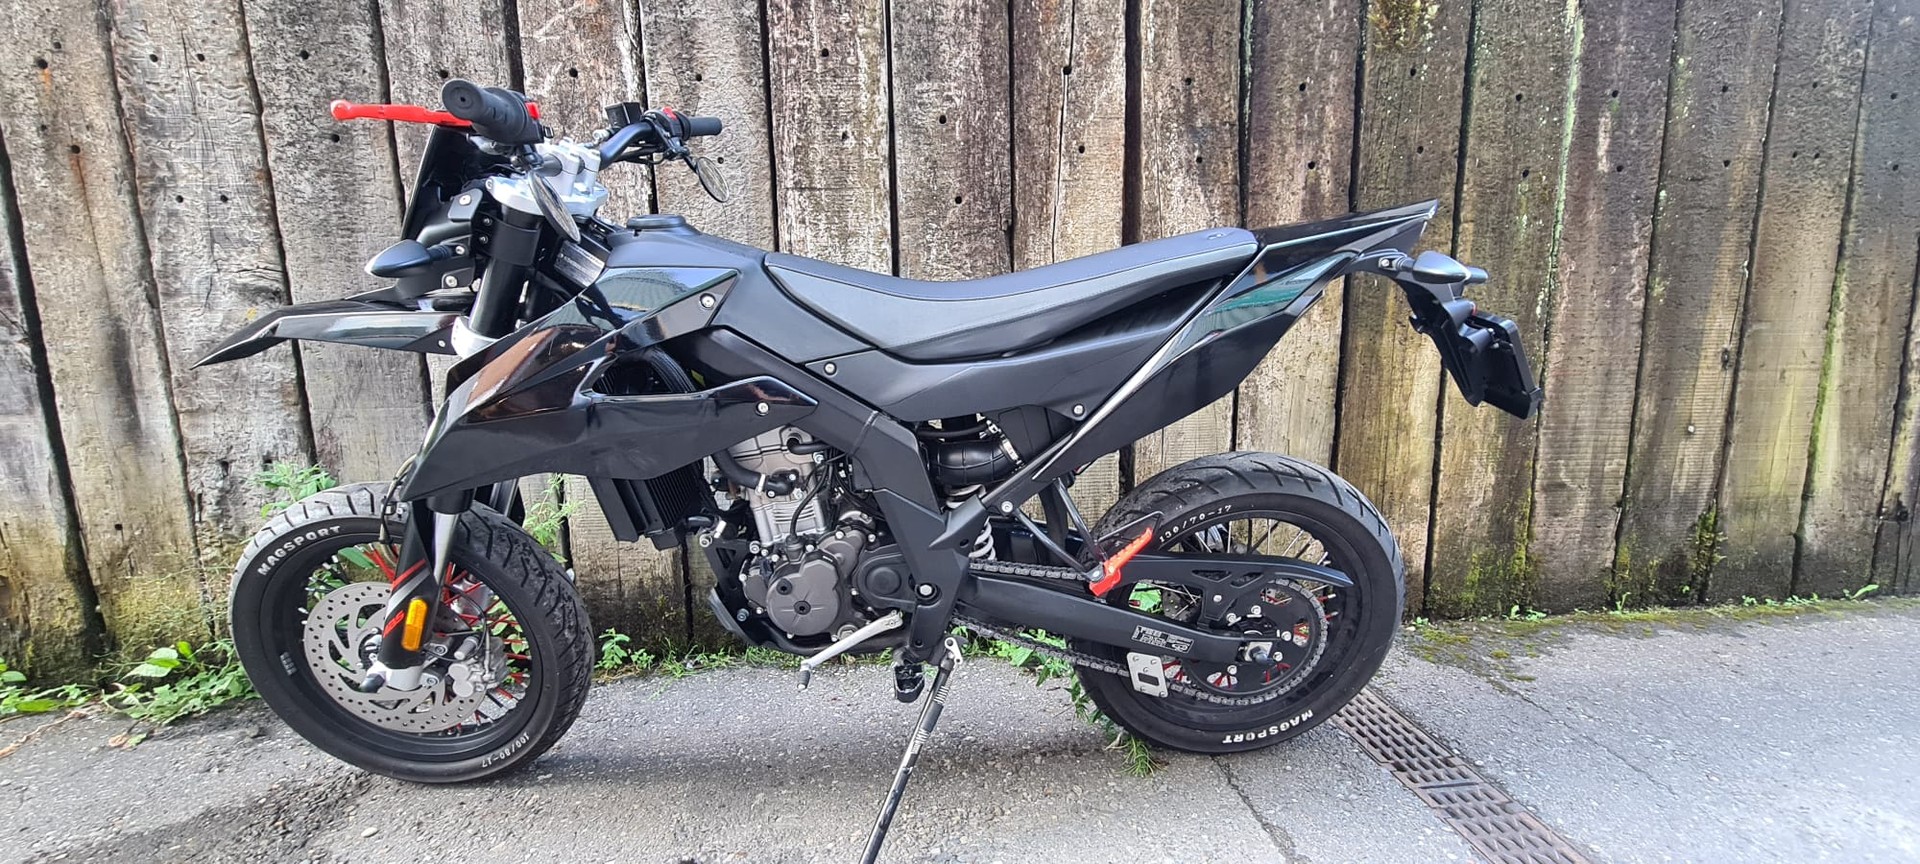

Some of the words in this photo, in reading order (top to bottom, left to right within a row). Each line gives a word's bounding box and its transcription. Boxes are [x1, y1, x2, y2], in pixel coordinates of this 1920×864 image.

[257, 525, 341, 576] MAGSPORT
[1222, 709, 1314, 744] MAGSPORT
[482, 731, 530, 768] 100/80-17
